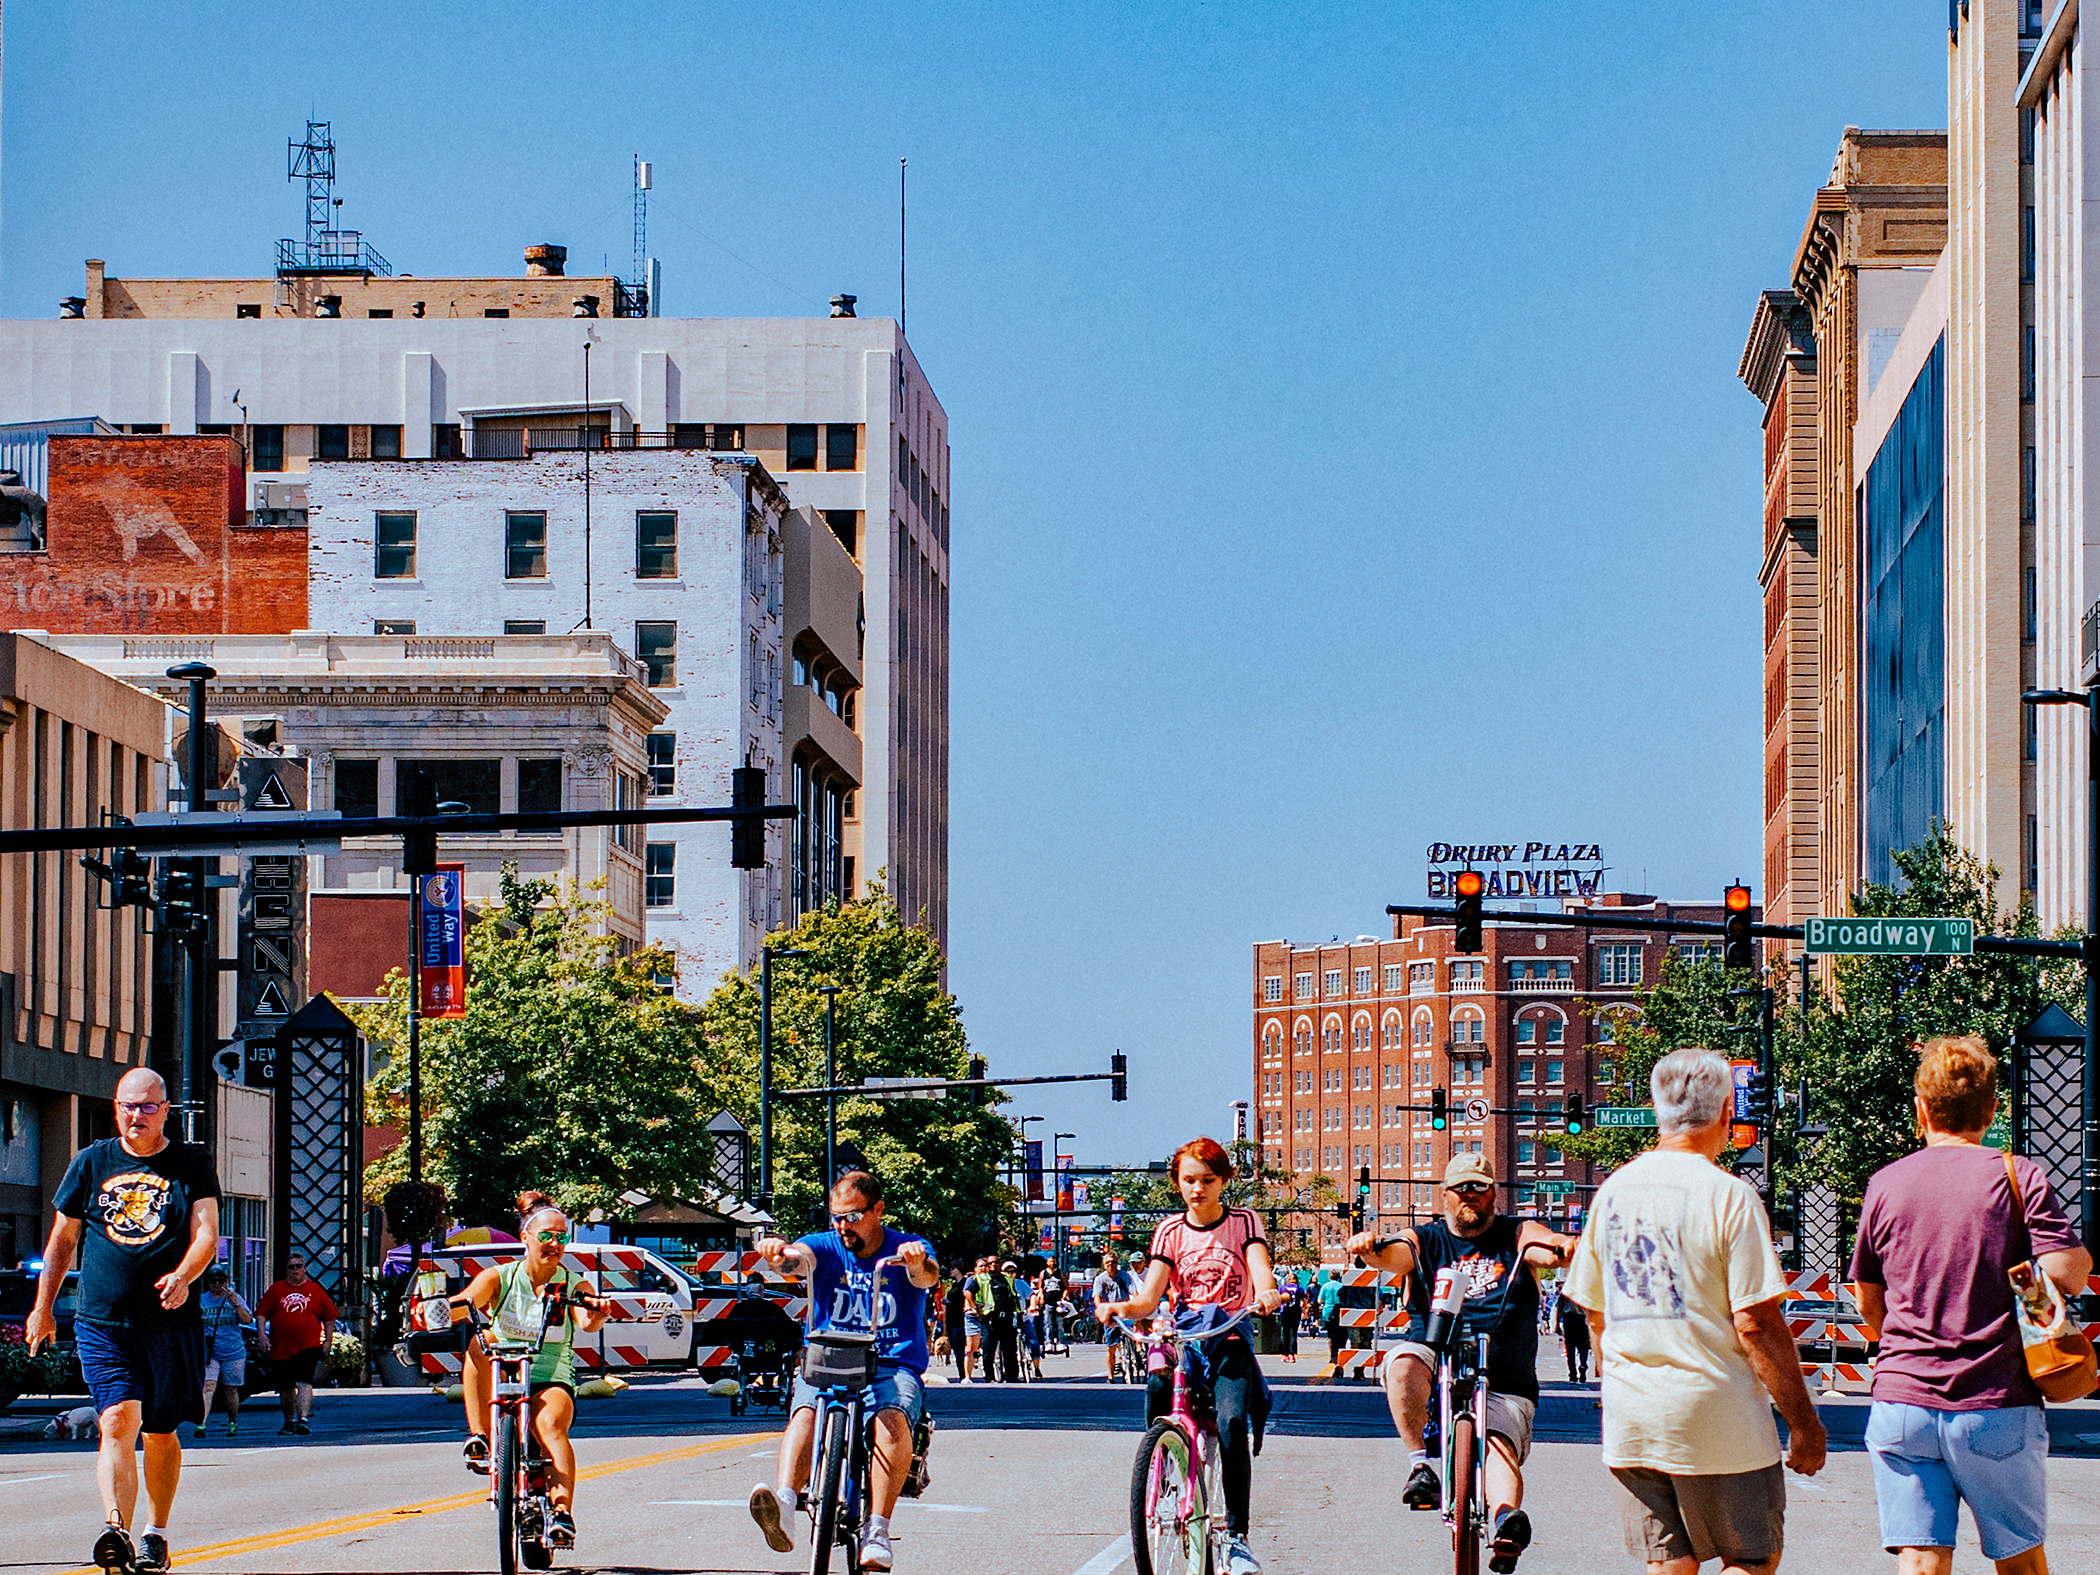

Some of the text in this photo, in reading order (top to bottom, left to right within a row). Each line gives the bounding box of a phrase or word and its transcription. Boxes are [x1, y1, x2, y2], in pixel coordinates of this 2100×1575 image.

[1427, 842, 1601, 863] DRURY PLAZA
[253, 773, 292, 1016] AHENA
[1428, 870, 1602, 897] BADVIEW
[427, 914, 440, 964] United
[442, 914, 458, 943] Way
[1810, 920, 1968, 953] Broadway 100
[1952, 938, 1960, 951] N
[1736, 1089, 1745, 1117] United
[1600, 1110, 1646, 1124] Market
[1539, 1182, 1560, 1192] Main
[845, 1269, 882, 1291] BES
[831, 1287, 897, 1327] DAD
[500, 1322, 526, 1337] FRESH
